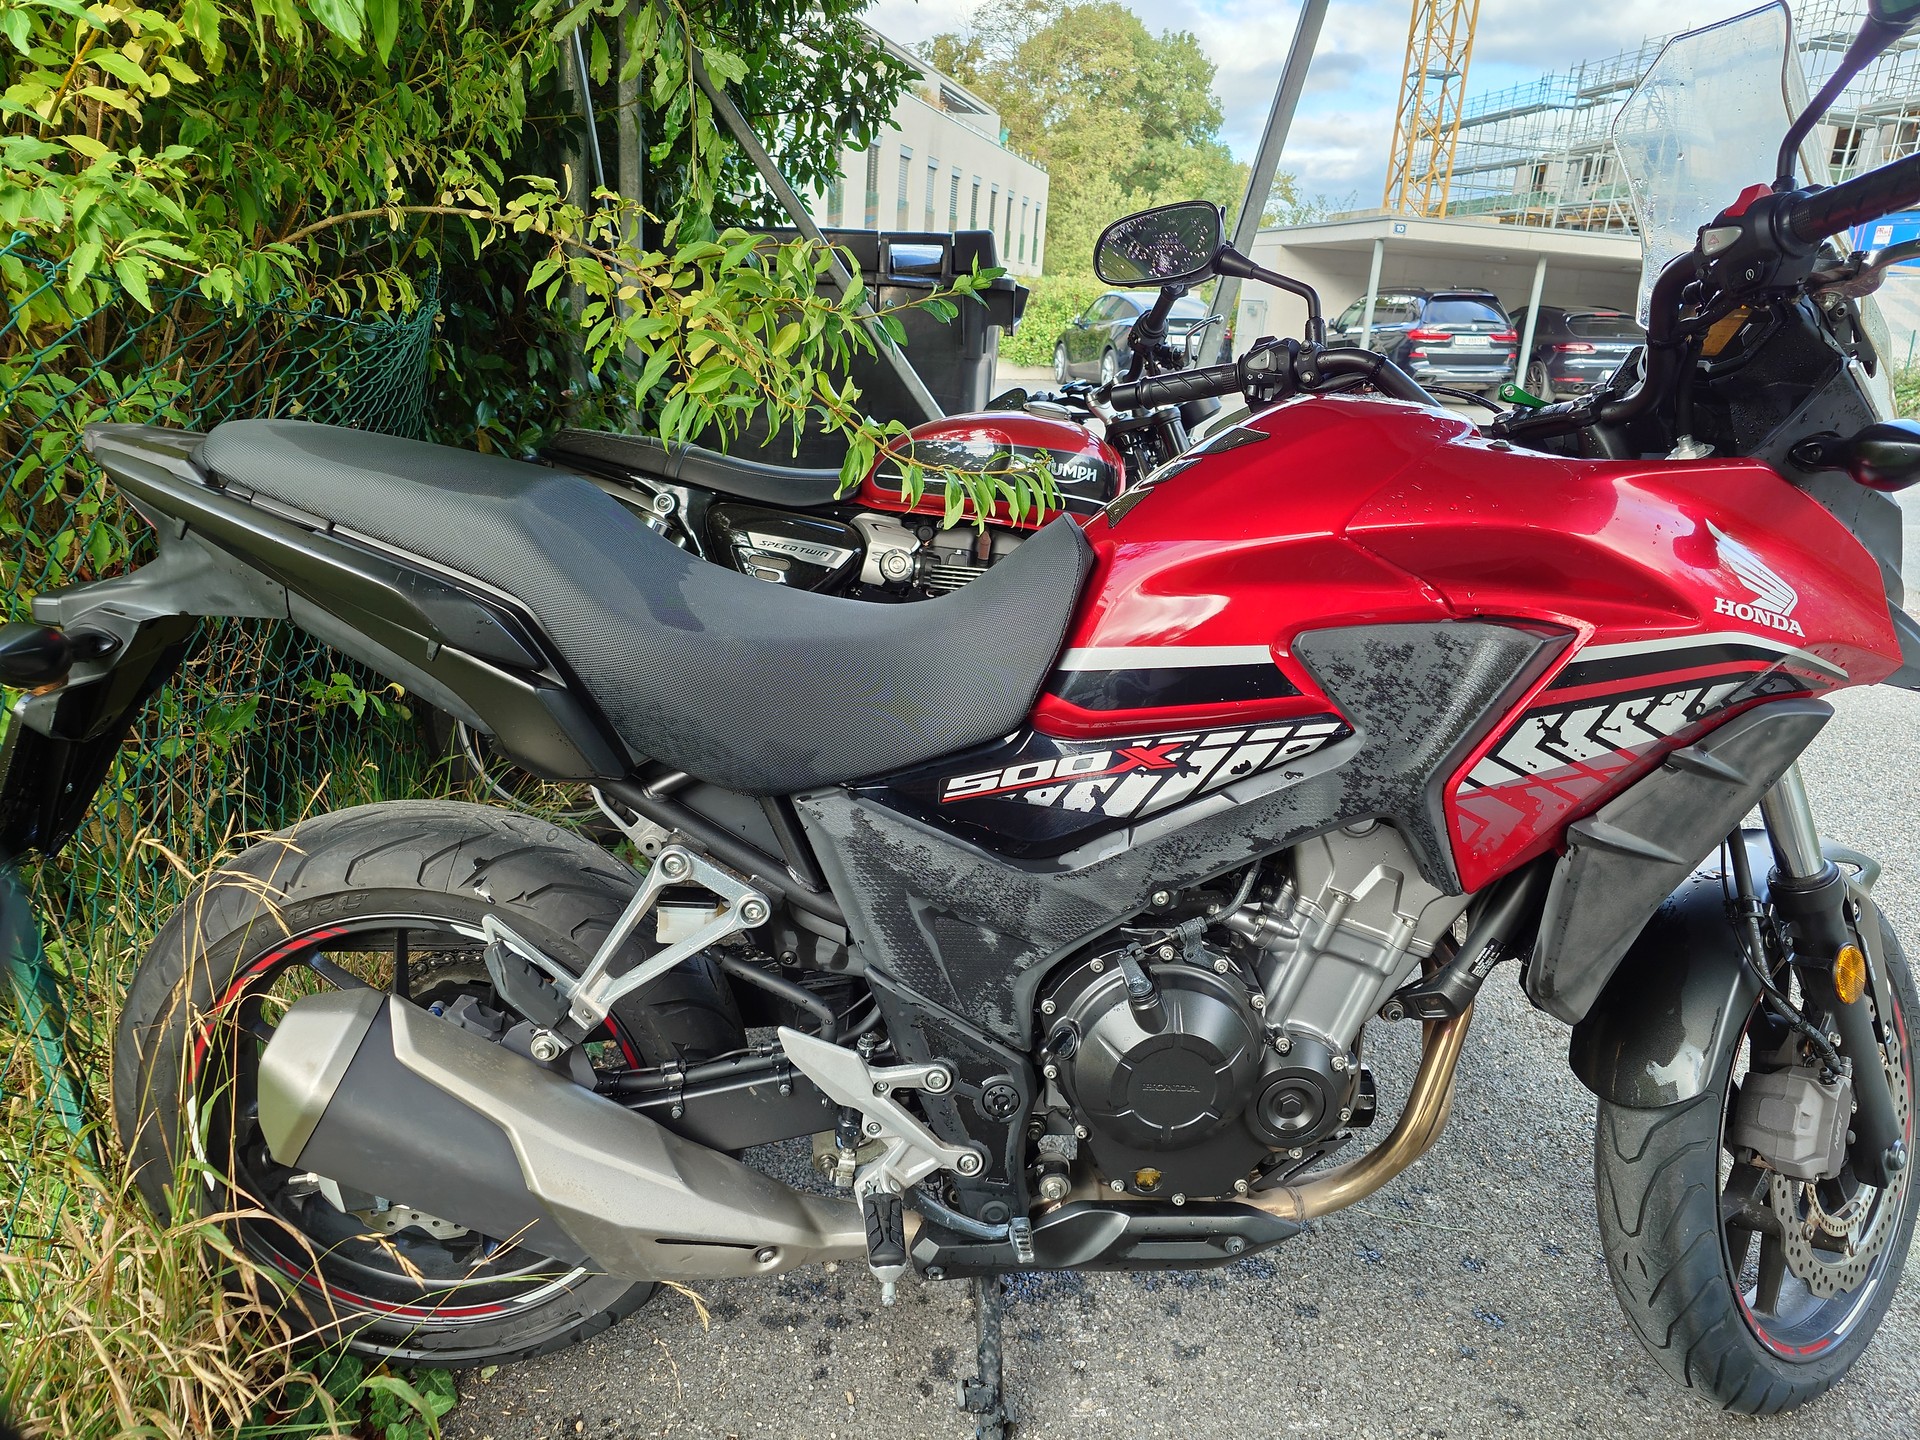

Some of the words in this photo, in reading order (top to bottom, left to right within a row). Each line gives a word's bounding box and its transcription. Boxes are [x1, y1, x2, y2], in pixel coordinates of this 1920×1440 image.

[1027, 459, 1098, 483] IUMPH
[759, 540, 798, 552] SPEED
[799, 547, 829, 558] TWIN
[1713, 597, 1806, 638] HONDA
[943, 743, 1184, 799] 500X
[1142, 1083, 1201, 1093] HONDA
